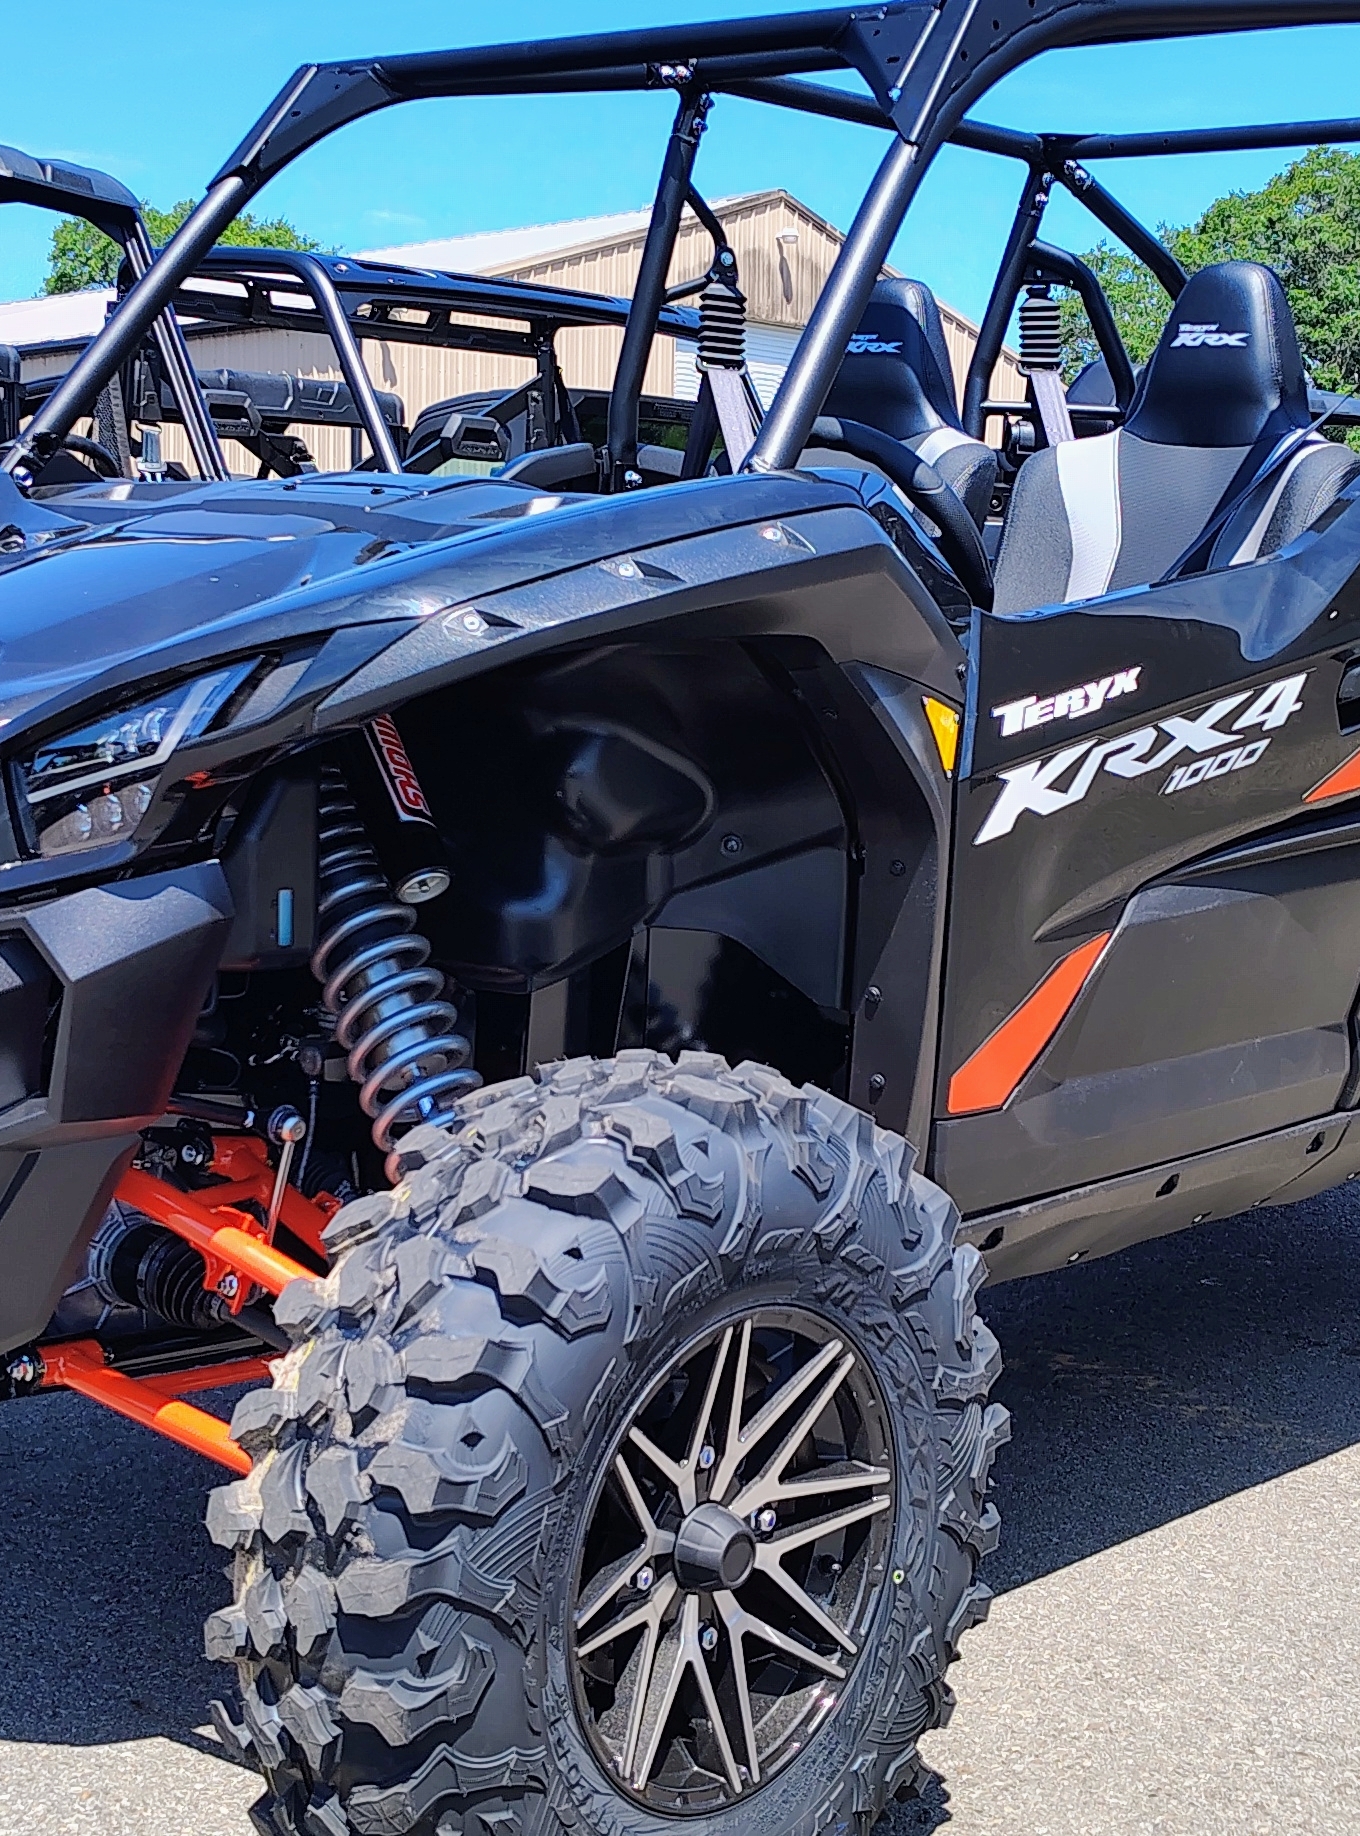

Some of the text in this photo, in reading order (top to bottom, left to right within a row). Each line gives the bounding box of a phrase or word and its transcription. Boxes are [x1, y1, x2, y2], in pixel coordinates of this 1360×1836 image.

[845, 341, 903, 353] KRX
[1170, 332, 1252, 348] KRX
[991, 665, 1143, 738] TERYX
[372, 712, 425, 810] SHOW
[1163, 737, 1272, 795] 1000
